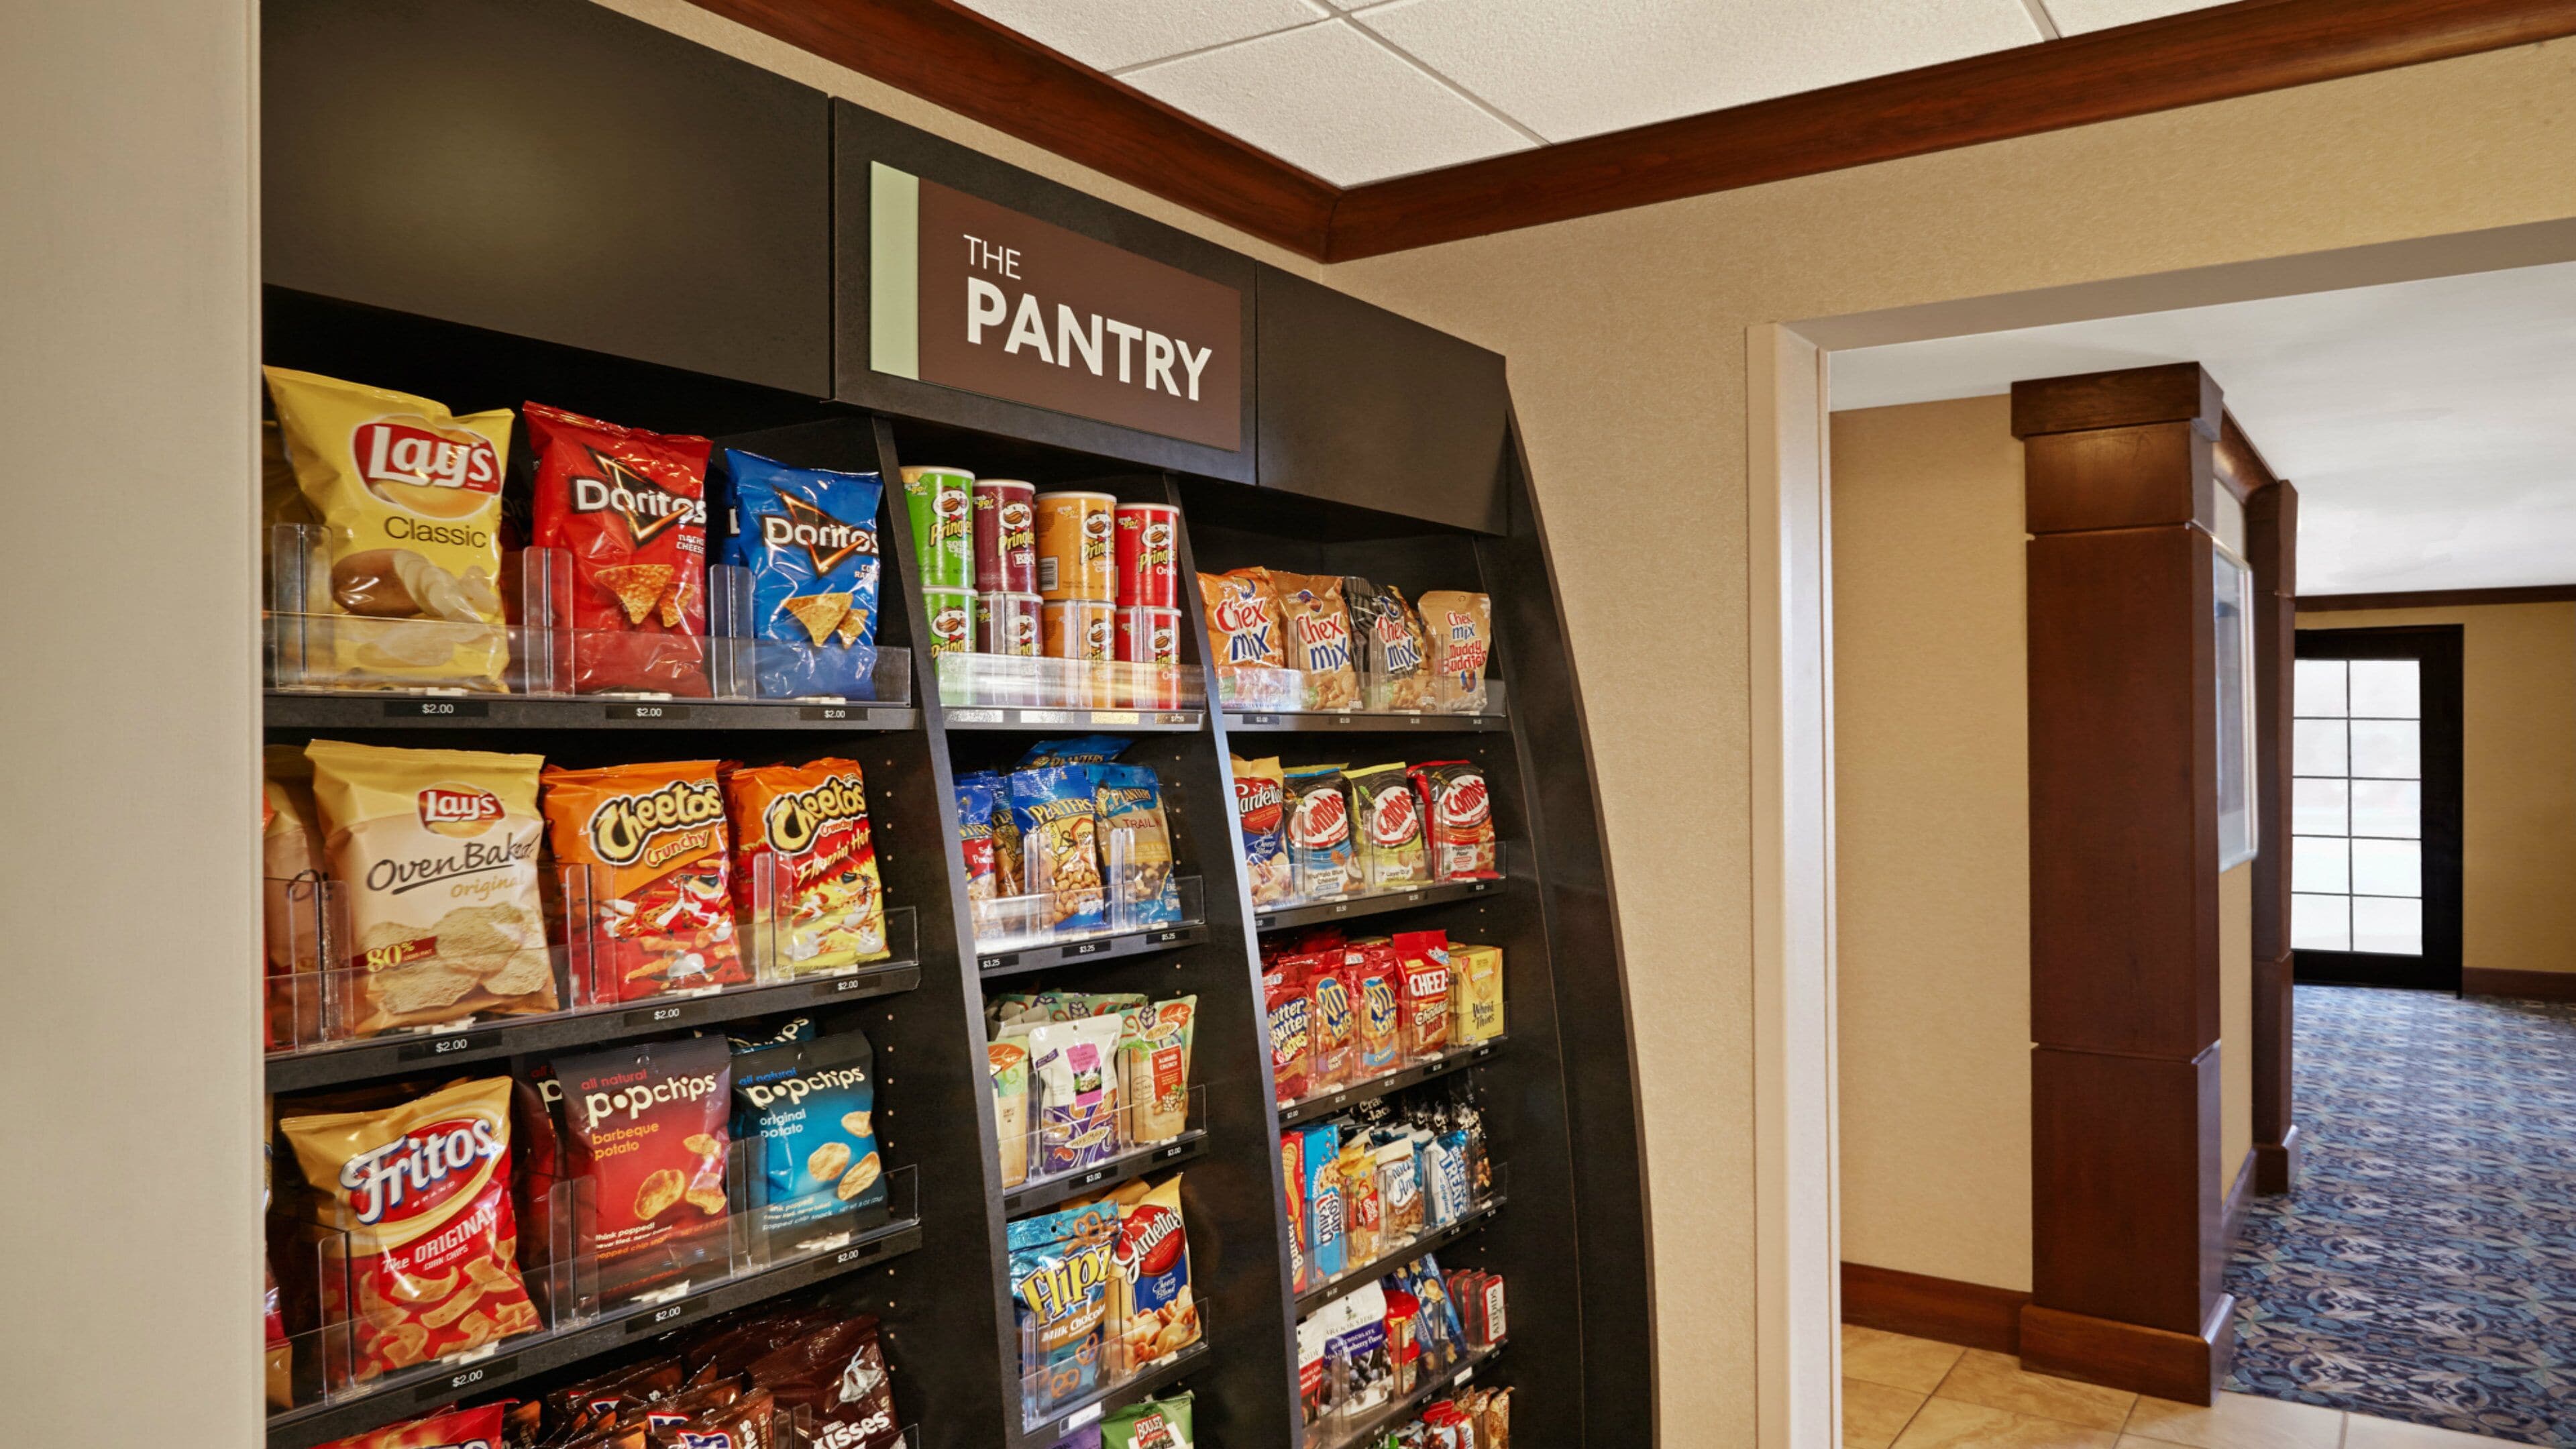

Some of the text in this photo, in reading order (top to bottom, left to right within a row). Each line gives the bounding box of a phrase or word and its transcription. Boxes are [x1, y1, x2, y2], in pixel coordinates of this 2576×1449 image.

[963, 234, 1021, 280] THE
[967, 276, 1212, 401] PANTRY
[368, 426, 494, 488] Lay's
[576, 479, 706, 525] Doritos
[384, 516, 486, 548] Classic
[1216, 600, 1268, 632] Chex
[1297, 614, 1344, 644] Chex
[422, 703, 453, 715] $2.00
[637, 708, 662, 718] $2.00
[824, 710, 845, 718] $2.00
[427, 792, 496, 822] Lay's
[771, 778, 866, 850] Cheetos
[596, 786, 724, 860] Cheetos
[645, 830, 710, 868] Crunchy
[837, 979, 859, 991] $2.00
[654, 1008, 680, 1020] $2.00
[436, 1039, 467, 1053] $2.00
[581, 1069, 647, 1090] all natural
[746, 1066, 865, 1109] popchips
[585, 1074, 716, 1128] popchips
[759, 1108, 806, 1127] original
[760, 1123, 804, 1138] potato
[592, 1122, 660, 1144] barbeque
[594, 1140, 640, 1162] potato
[340, 1119, 490, 1224] Fritos
[839, 1249, 859, 1263] $2.00
[655, 1307, 682, 1322] $2.00
[452, 1371, 484, 1387] $2.00
